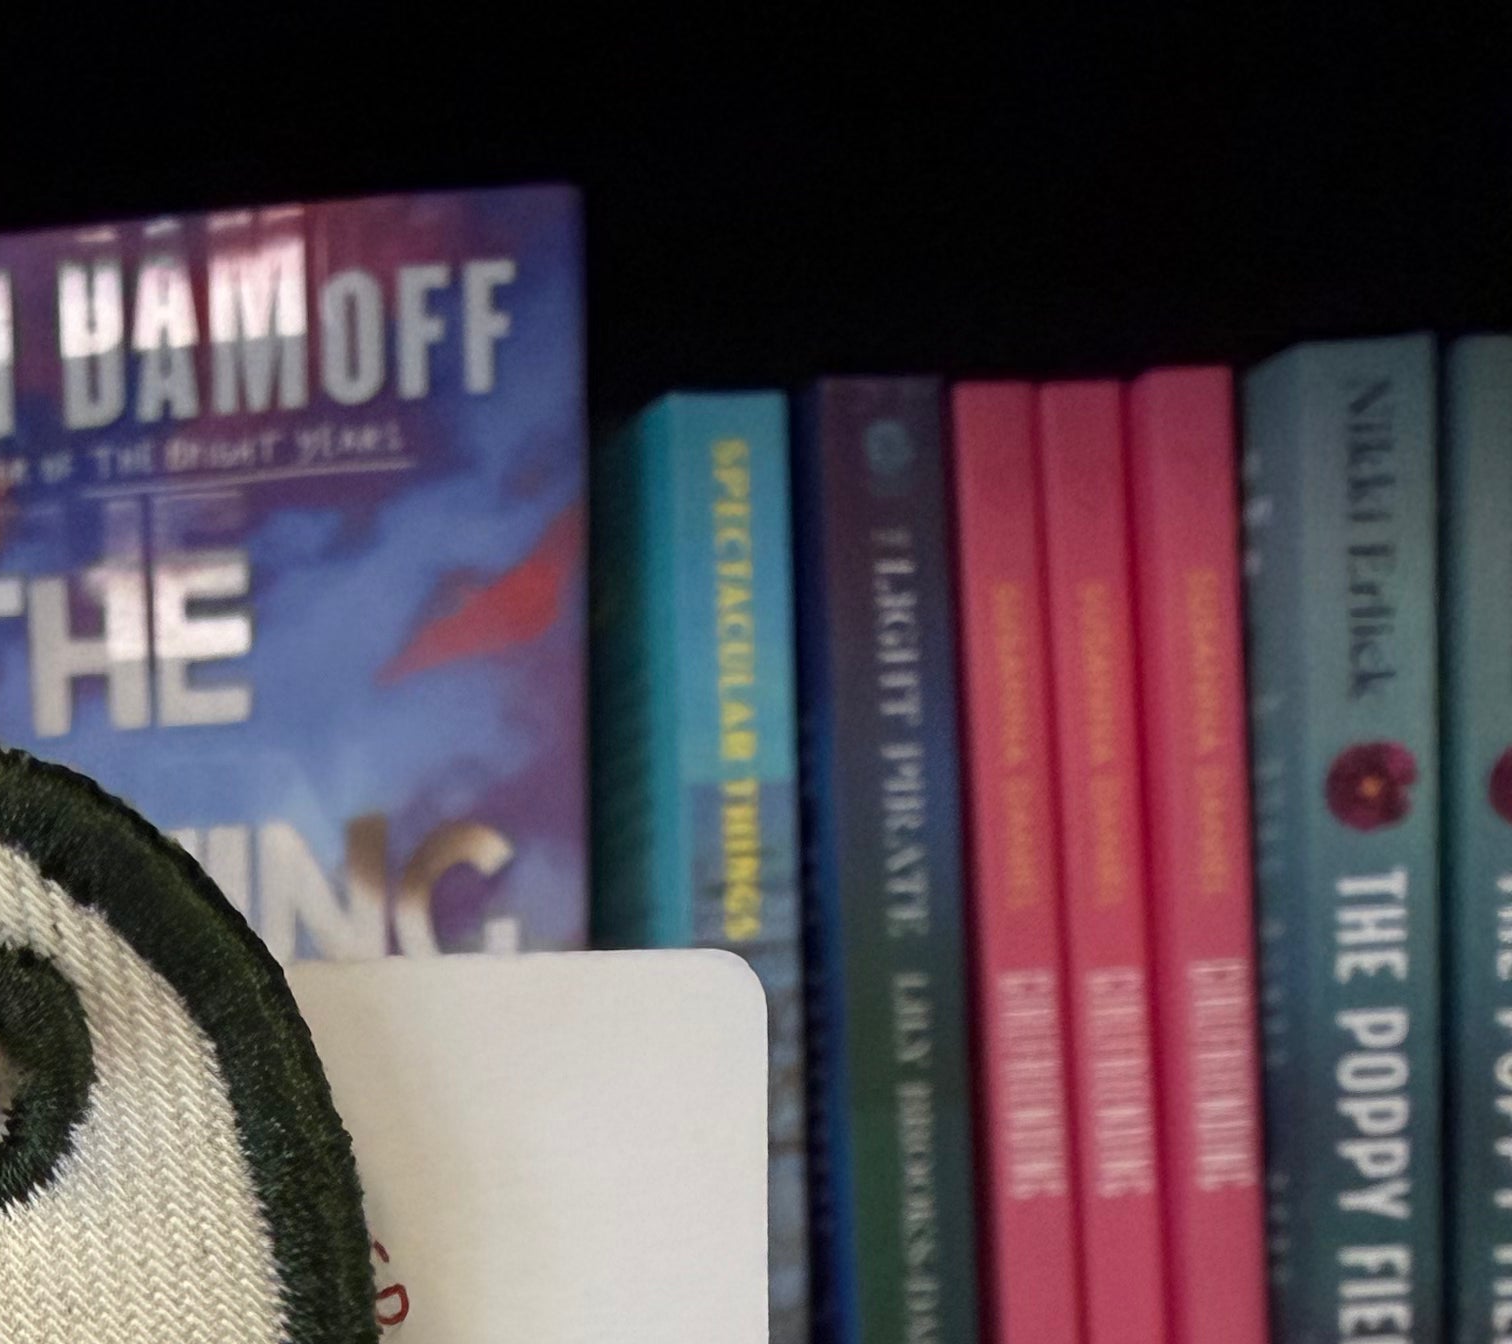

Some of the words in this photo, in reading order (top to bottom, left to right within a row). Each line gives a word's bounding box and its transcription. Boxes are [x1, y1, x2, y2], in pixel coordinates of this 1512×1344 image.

[56, 235, 518, 432] DAMOFF
[1346, 377, 1397, 524] Nikki
[710, 437, 757, 761] SPECTACULAR
[1346, 541, 1399, 702] Erlick
[720, 778, 763, 942] THINGS
[1334, 866, 1410, 984] THE
[1336, 1006, 1413, 1220] POPPY
